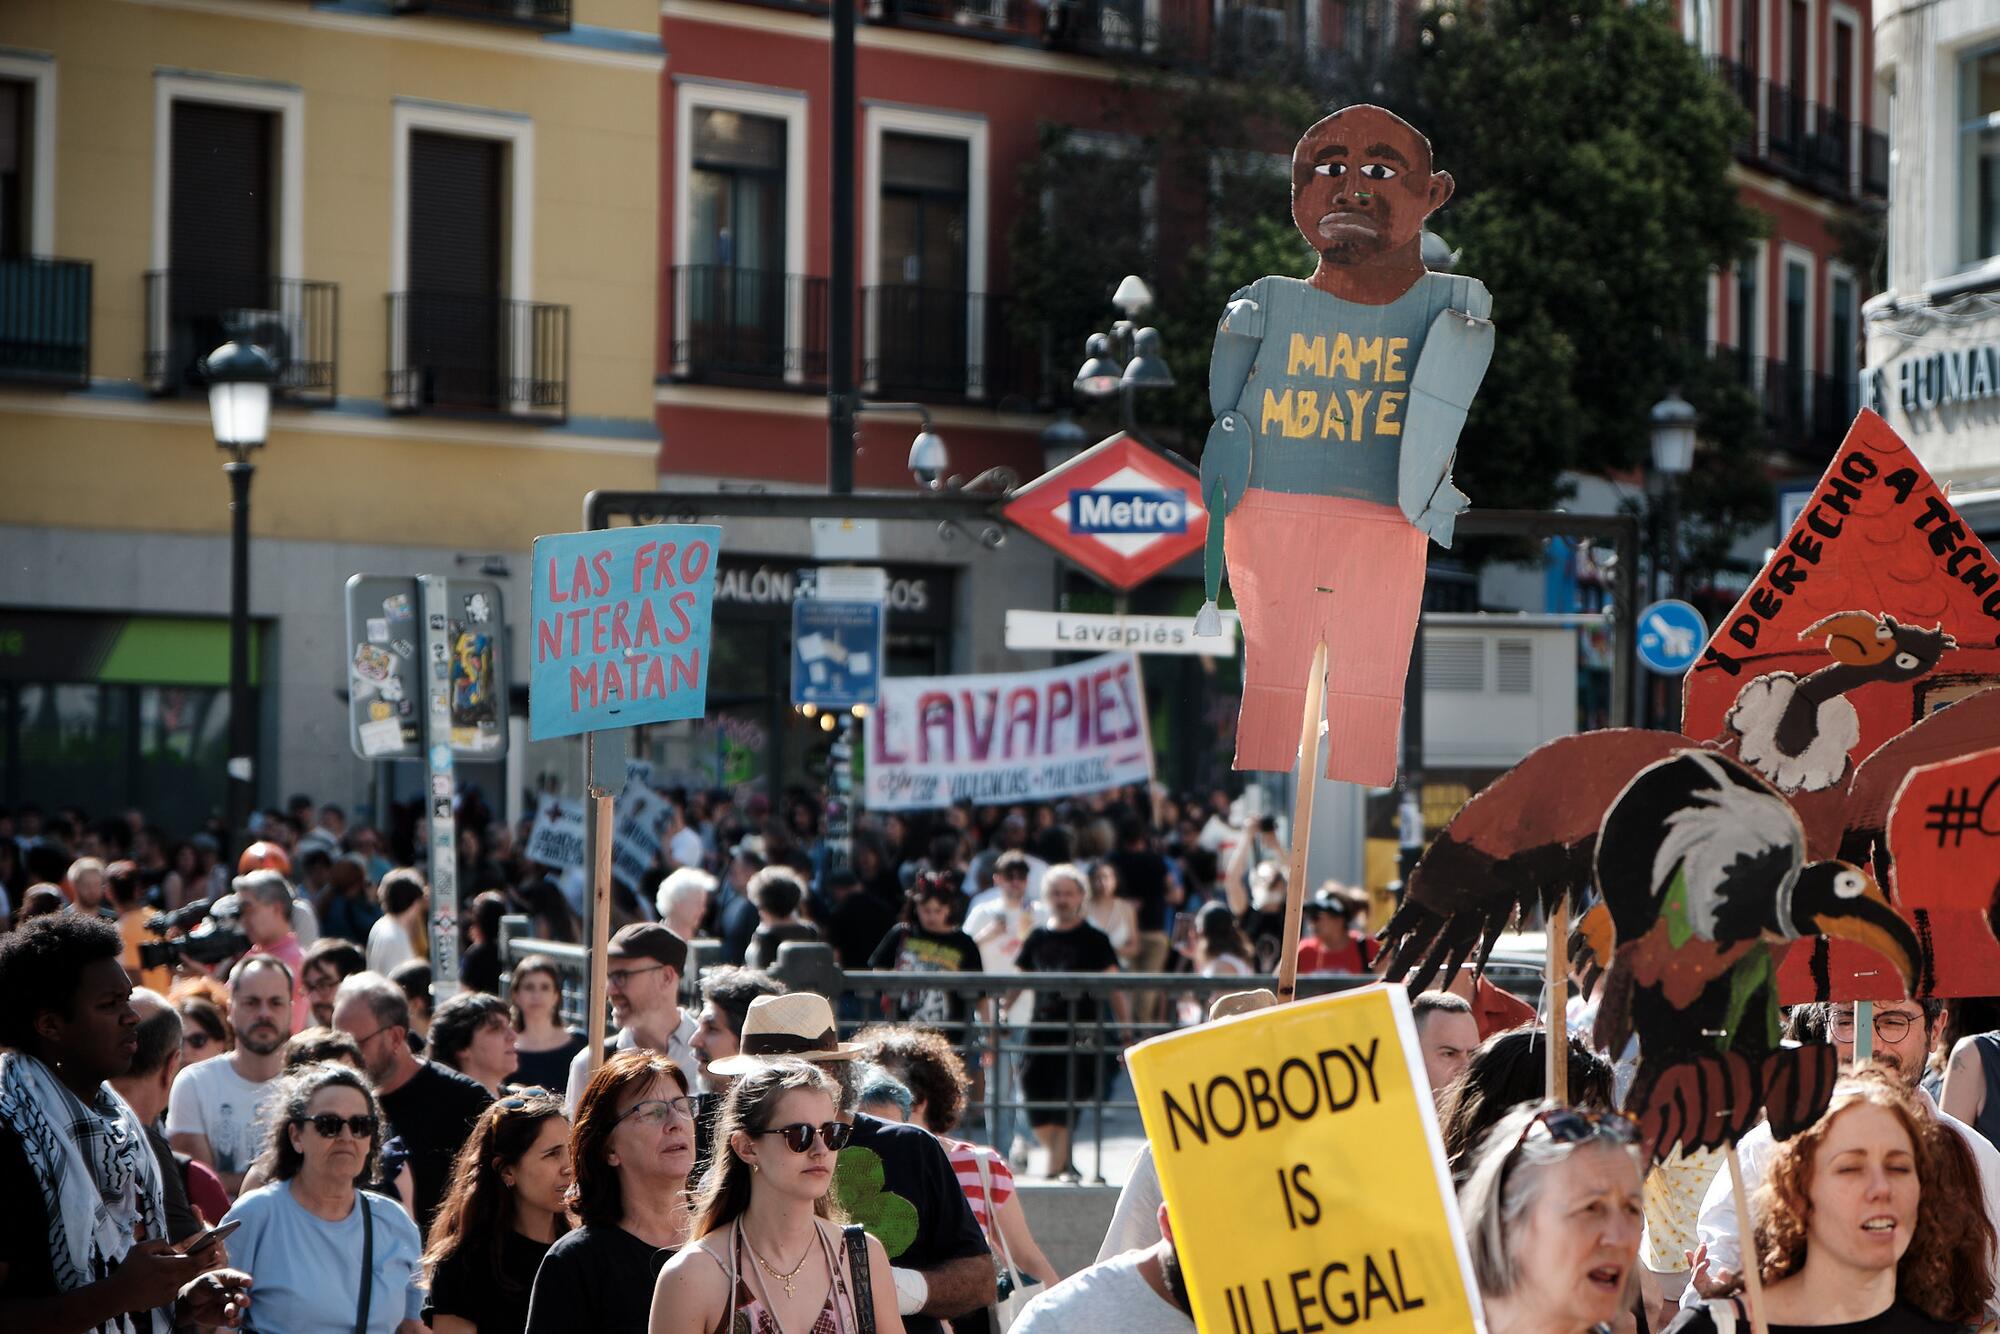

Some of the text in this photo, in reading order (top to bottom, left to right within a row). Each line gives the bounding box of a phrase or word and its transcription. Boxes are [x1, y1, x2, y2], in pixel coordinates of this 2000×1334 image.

[1287, 332, 1409, 383] MAME
[1261, 387, 1408, 442] MBAYE
[1078, 494, 1180, 528] Metro
[549, 540, 710, 603] LAS FRO
[1729, 452, 1878, 650] DERECHO
[1884, 466, 1919, 504] A
[538, 591, 696, 663] NTERAS
[1056, 620, 1185, 647] Lavapiés
[570, 647, 701, 713] MATAN
[874, 661, 1140, 765] LAVAPIES
[1161, 1038, 1380, 1151] NOBODY
[1277, 1163, 1322, 1230] IS
[1225, 1249, 1426, 1334] ILLEGAL
